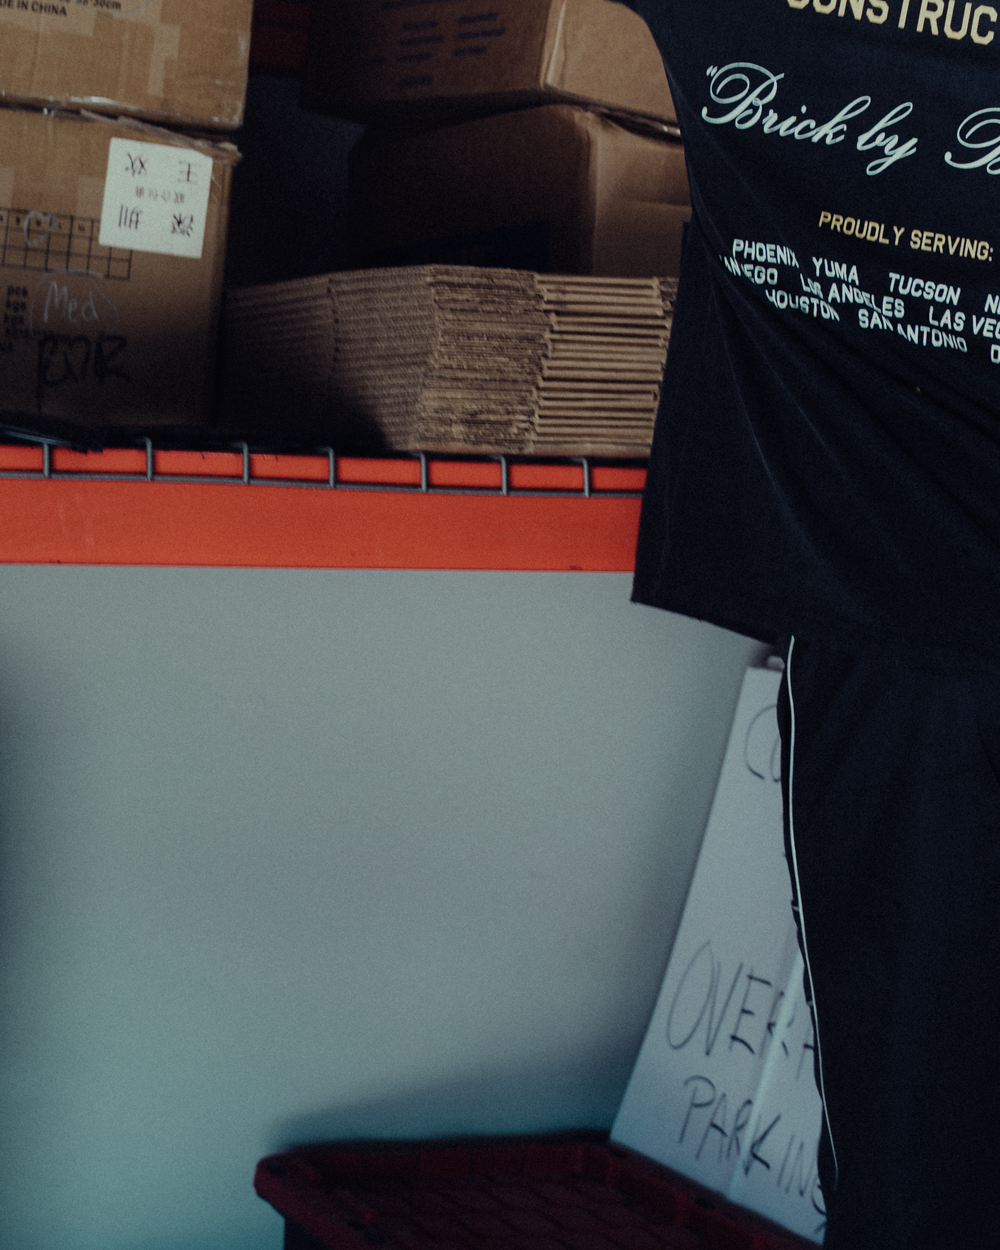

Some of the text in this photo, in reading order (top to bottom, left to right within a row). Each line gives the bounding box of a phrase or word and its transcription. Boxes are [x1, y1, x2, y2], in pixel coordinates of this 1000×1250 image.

[17, 0, 29, 11] IN
[31, 1, 67, 17] CHINA
[857, 101, 917, 176] by
[818, 210, 994, 262] PROUDLY SERVING:
[732, 238, 800, 269] PHOENIX
[812, 256, 860, 286] YUMA
[888, 271, 961, 306] TUCSON
[44, 281, 99, 324] Med
[828, 282, 905, 319] ANGELES
[929, 305, 966, 332] LAS
[858, 308, 894, 332] SAN
[897, 323, 968, 353] ANTONIO
